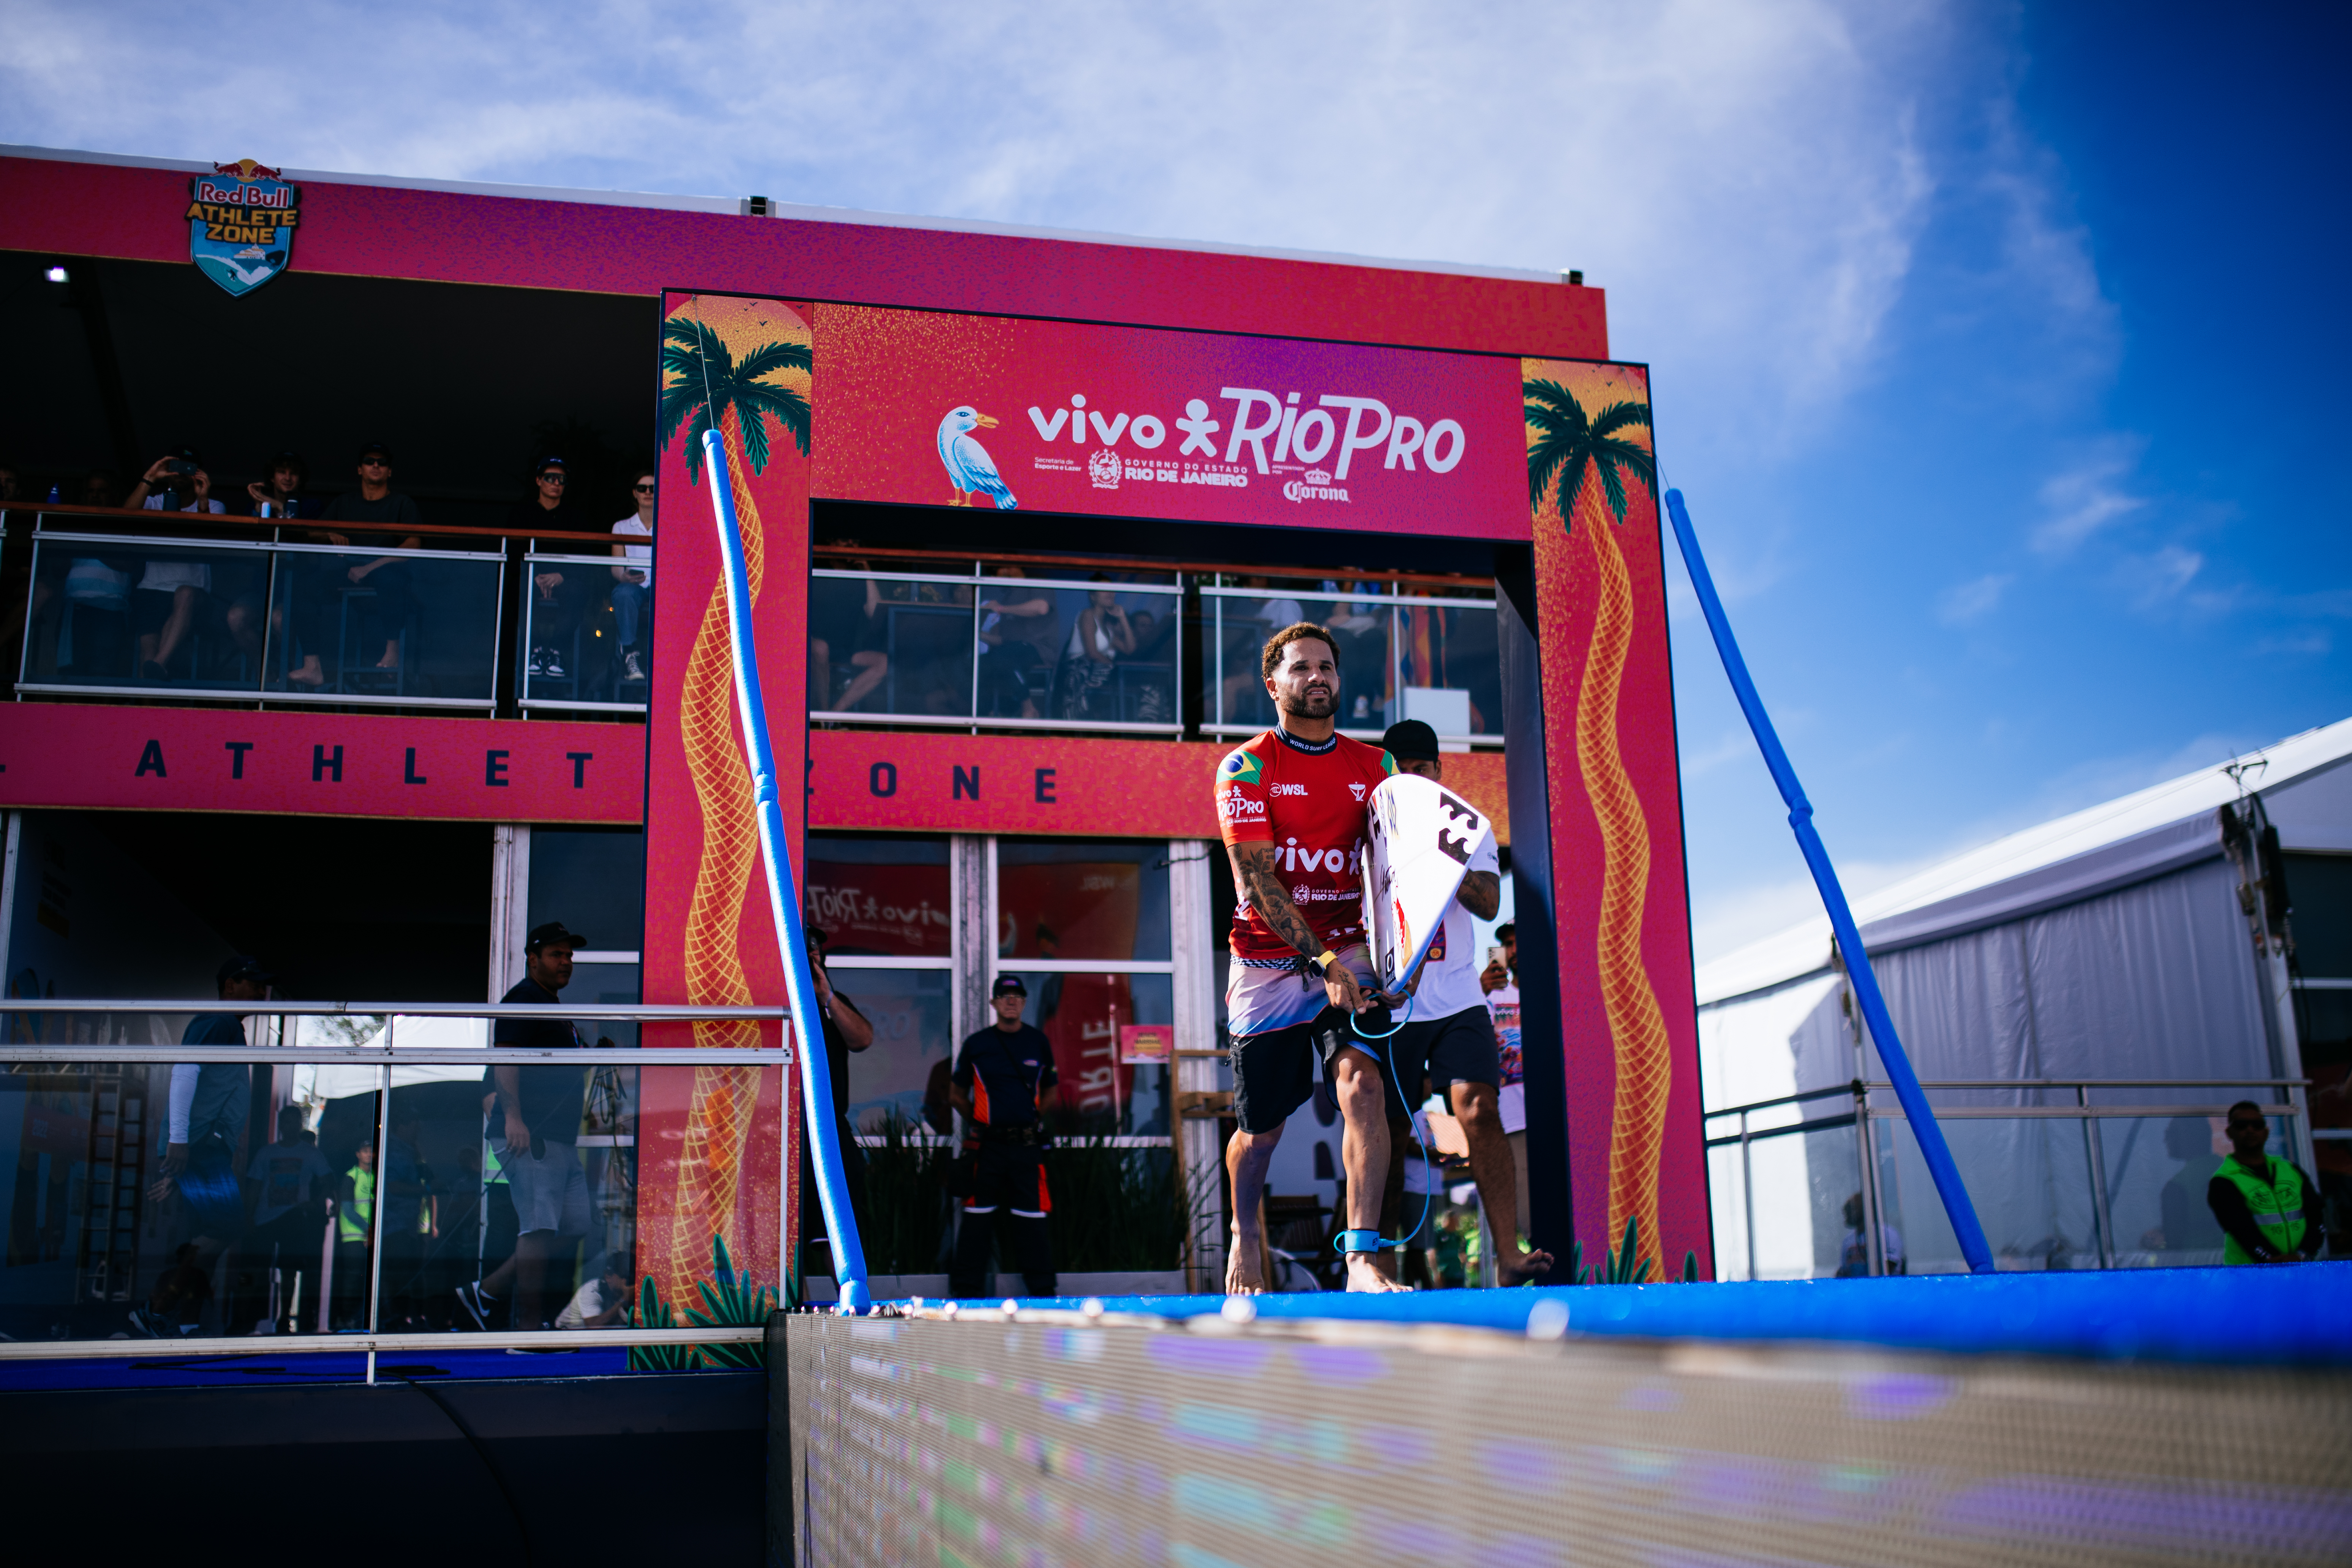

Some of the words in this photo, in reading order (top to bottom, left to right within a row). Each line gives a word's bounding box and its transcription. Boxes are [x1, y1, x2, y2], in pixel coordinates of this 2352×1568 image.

[199, 182, 244, 204] Red
[246, 186, 289, 208] Bull
[187, 202, 297, 226] ATHLETE
[206, 223, 275, 243] ZONE
[1027, 394, 1165, 449] vivo
[1125, 459, 1179, 469] GOVERNO
[1205, 464, 1248, 474] ESTADO
[1125, 468, 1154, 482] RIO
[1157, 469, 1178, 483] DE
[1181, 471, 1248, 487] JANEIRO
[1283, 481, 1349, 504] Corona
[1290, 739, 1309, 750] WORLD
[134, 739, 593, 789] ATHLET
[808, 759, 1057, 804] ONE
[1216, 789, 1232, 801] vivo
[1282, 784, 1308, 795] WSL
